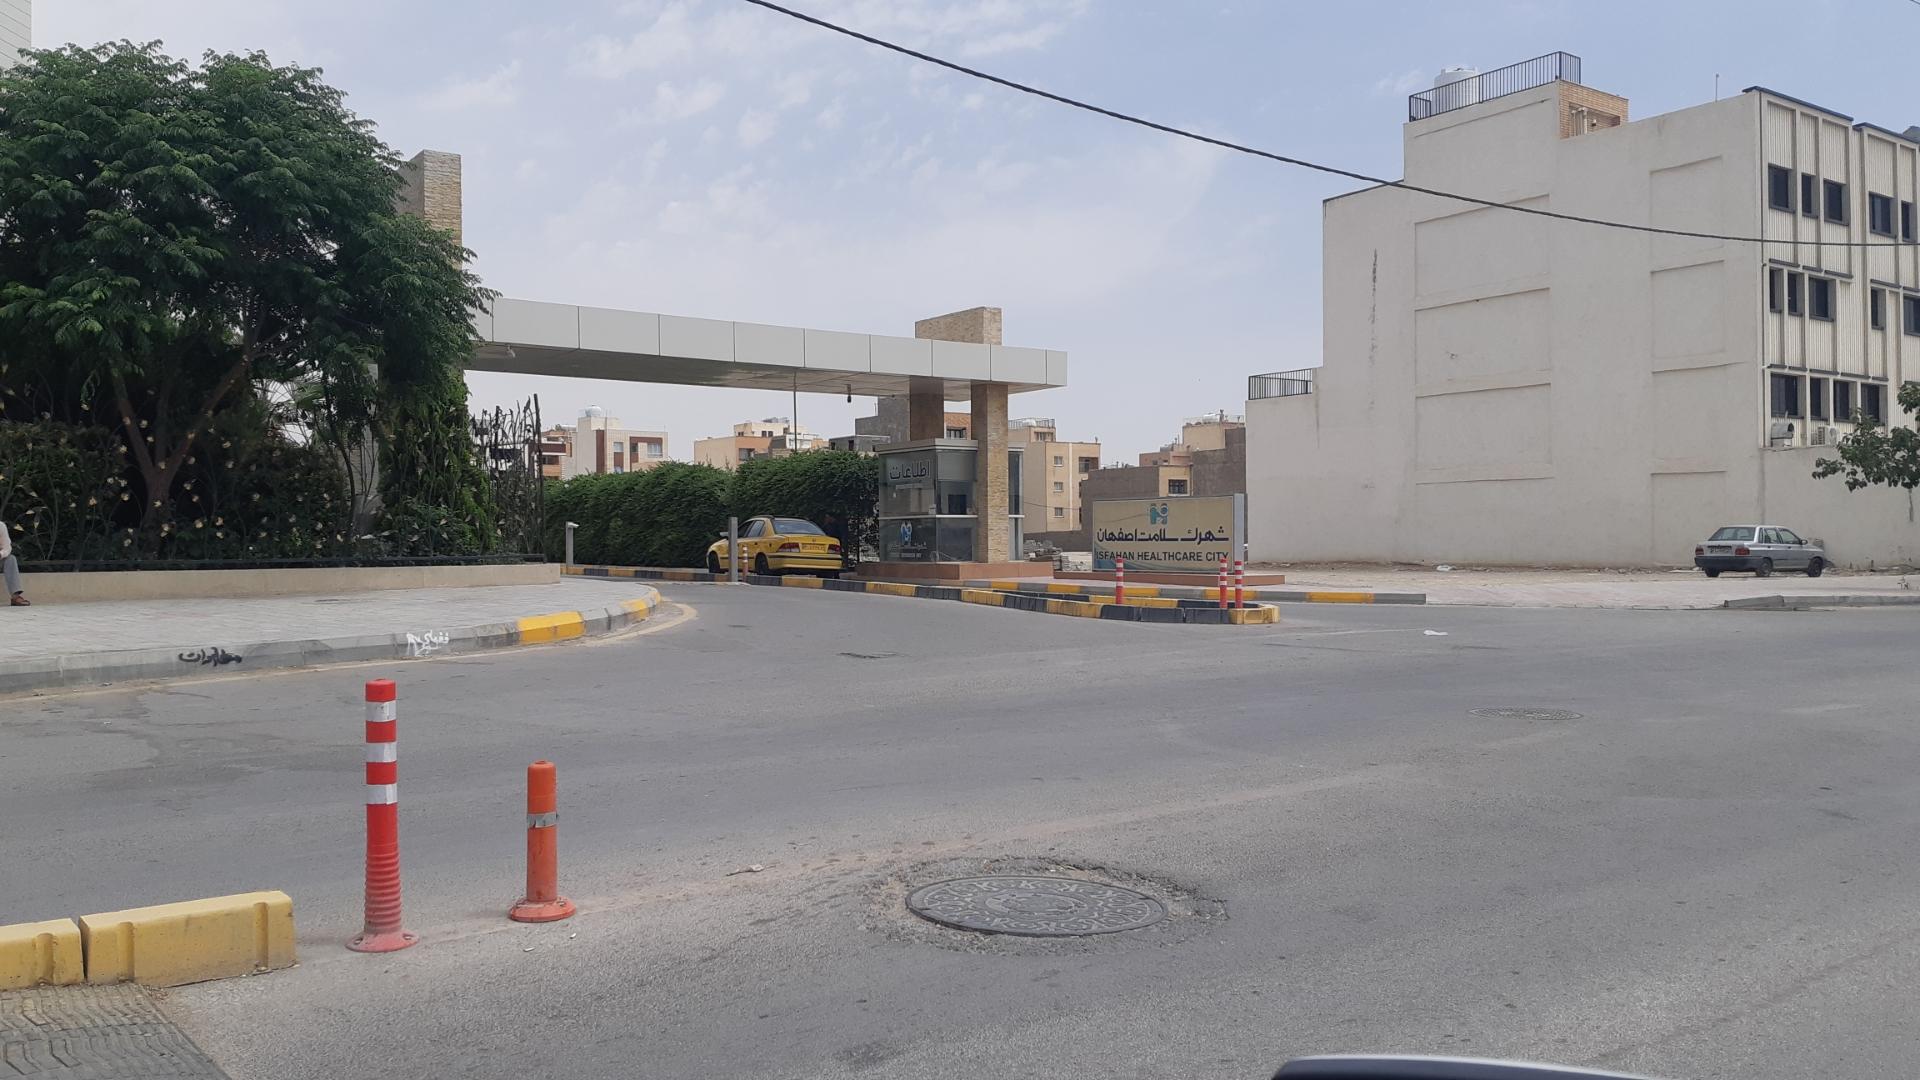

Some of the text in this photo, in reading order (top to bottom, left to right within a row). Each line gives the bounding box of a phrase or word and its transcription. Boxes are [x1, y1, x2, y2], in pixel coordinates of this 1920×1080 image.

[889, 461, 930, 479] اطلاعات
[1097, 526, 1229, 545] شهرک سلامت اصفهان
[1096, 551, 1229, 562] ISFAHAN HEALTHCARE CITY
